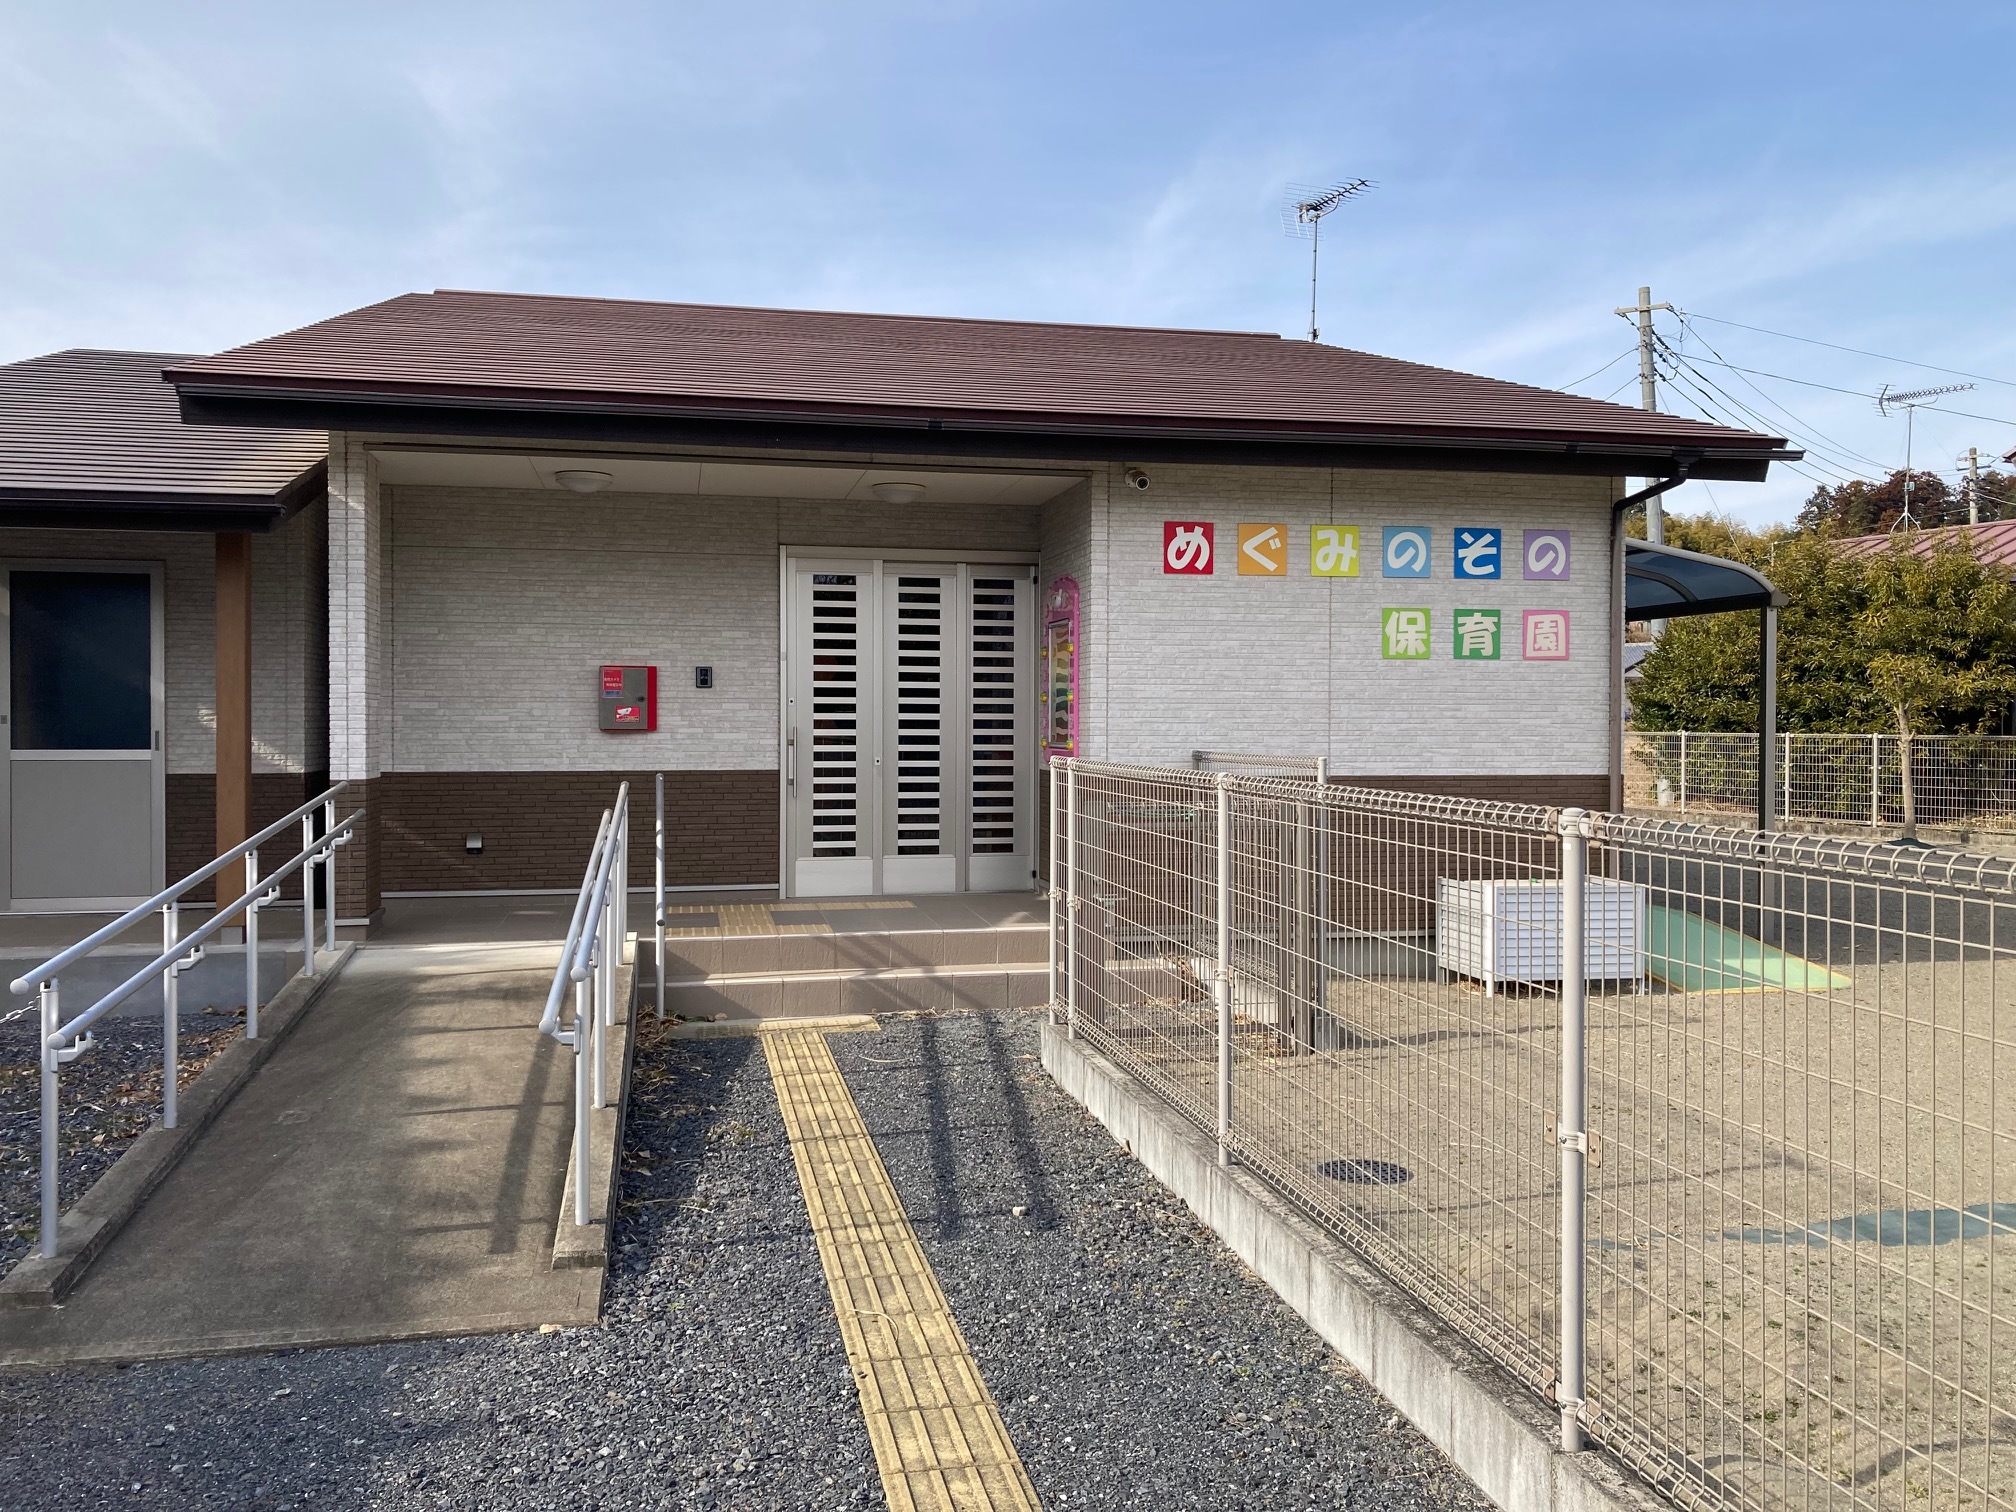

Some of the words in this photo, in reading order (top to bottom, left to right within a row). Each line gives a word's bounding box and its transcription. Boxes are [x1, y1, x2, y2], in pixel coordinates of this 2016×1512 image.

[1166, 525, 1567, 576] めぐみのその
[1385, 611, 1565, 658] 保育園
